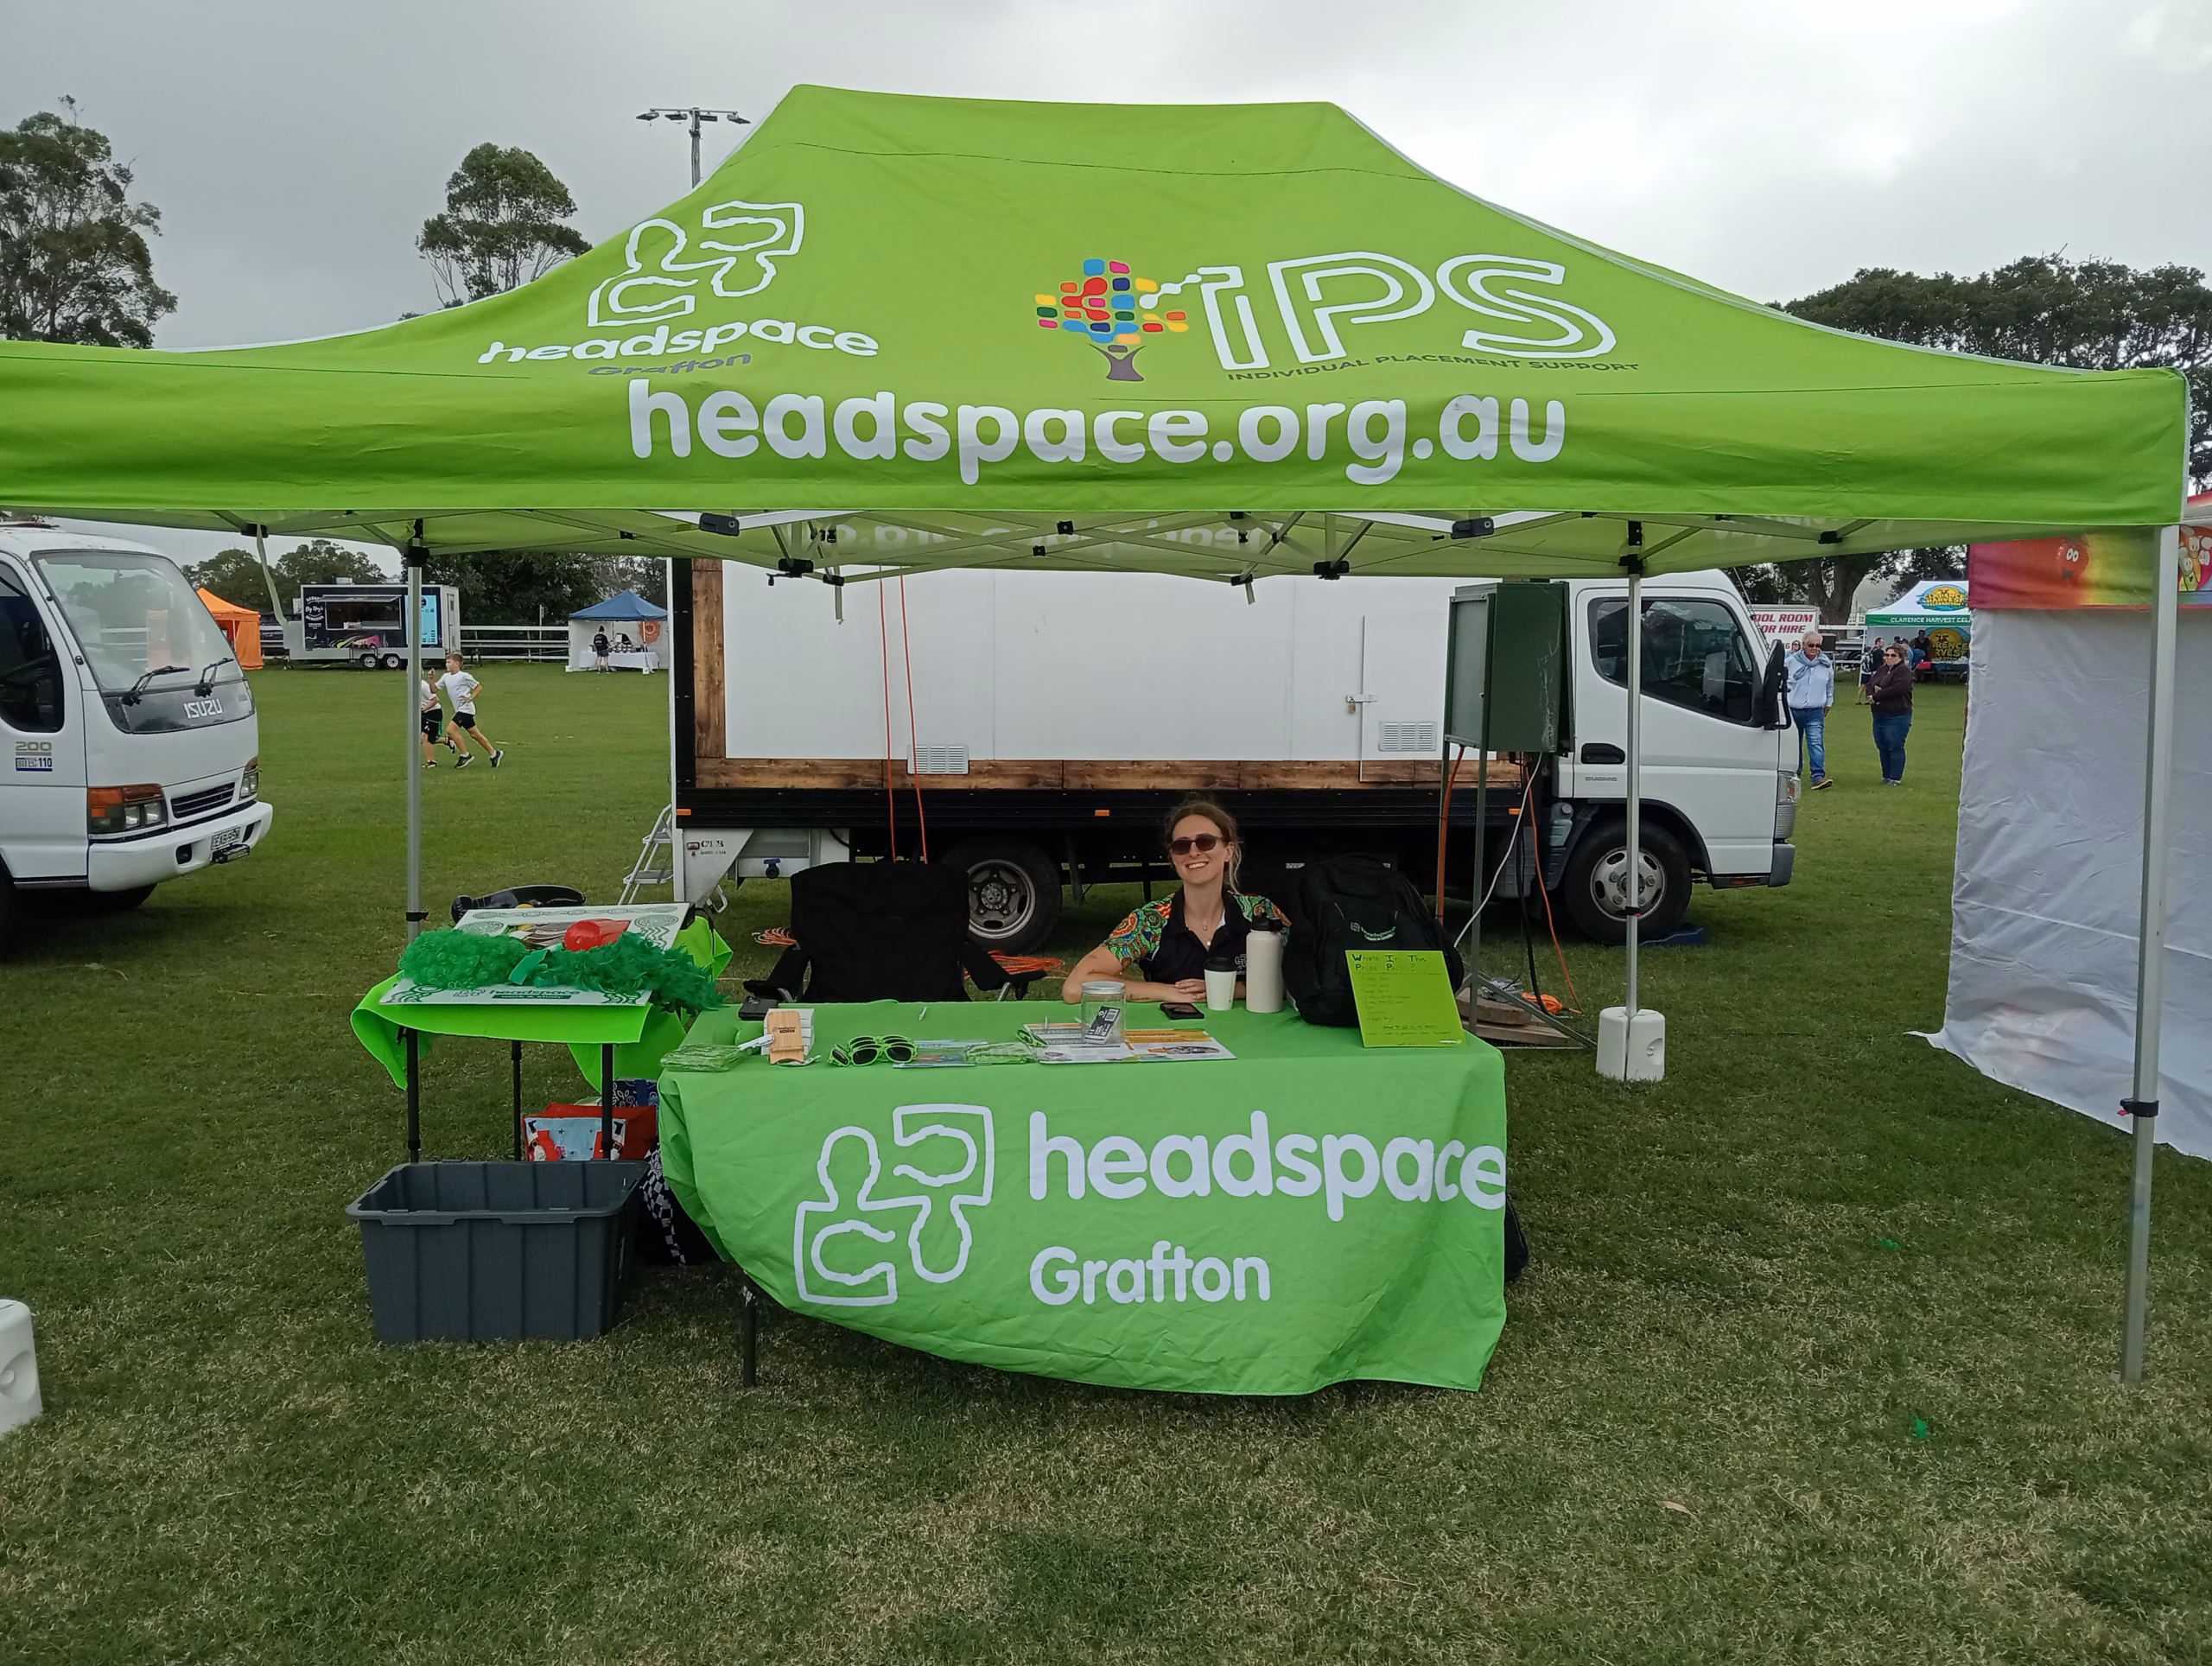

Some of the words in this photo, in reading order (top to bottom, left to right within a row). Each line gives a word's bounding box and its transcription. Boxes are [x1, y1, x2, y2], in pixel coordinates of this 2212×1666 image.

[477, 318, 880, 364] headspace
[588, 353, 752, 376] Grafton
[1228, 359, 1370, 380] INDIVIDUAL
[1375, 354, 1521, 368] PLACEMENT
[1528, 360, 1639, 372] SUPPORT
[628, 378, 1567, 486] headspace.org.au
[1754, 614, 1776, 622] OOL
[1778, 614, 1814, 622] ROOM
[1760, 625, 1777, 633] OR
[1778, 625, 1807, 633] HIRE
[183, 698, 223, 719] ISUZU
[16, 741, 52, 751] 200
[38, 757, 53, 767] 110
[1029, 1110, 1507, 1222] headspace
[1029, 1240, 1271, 1307] Grafton
